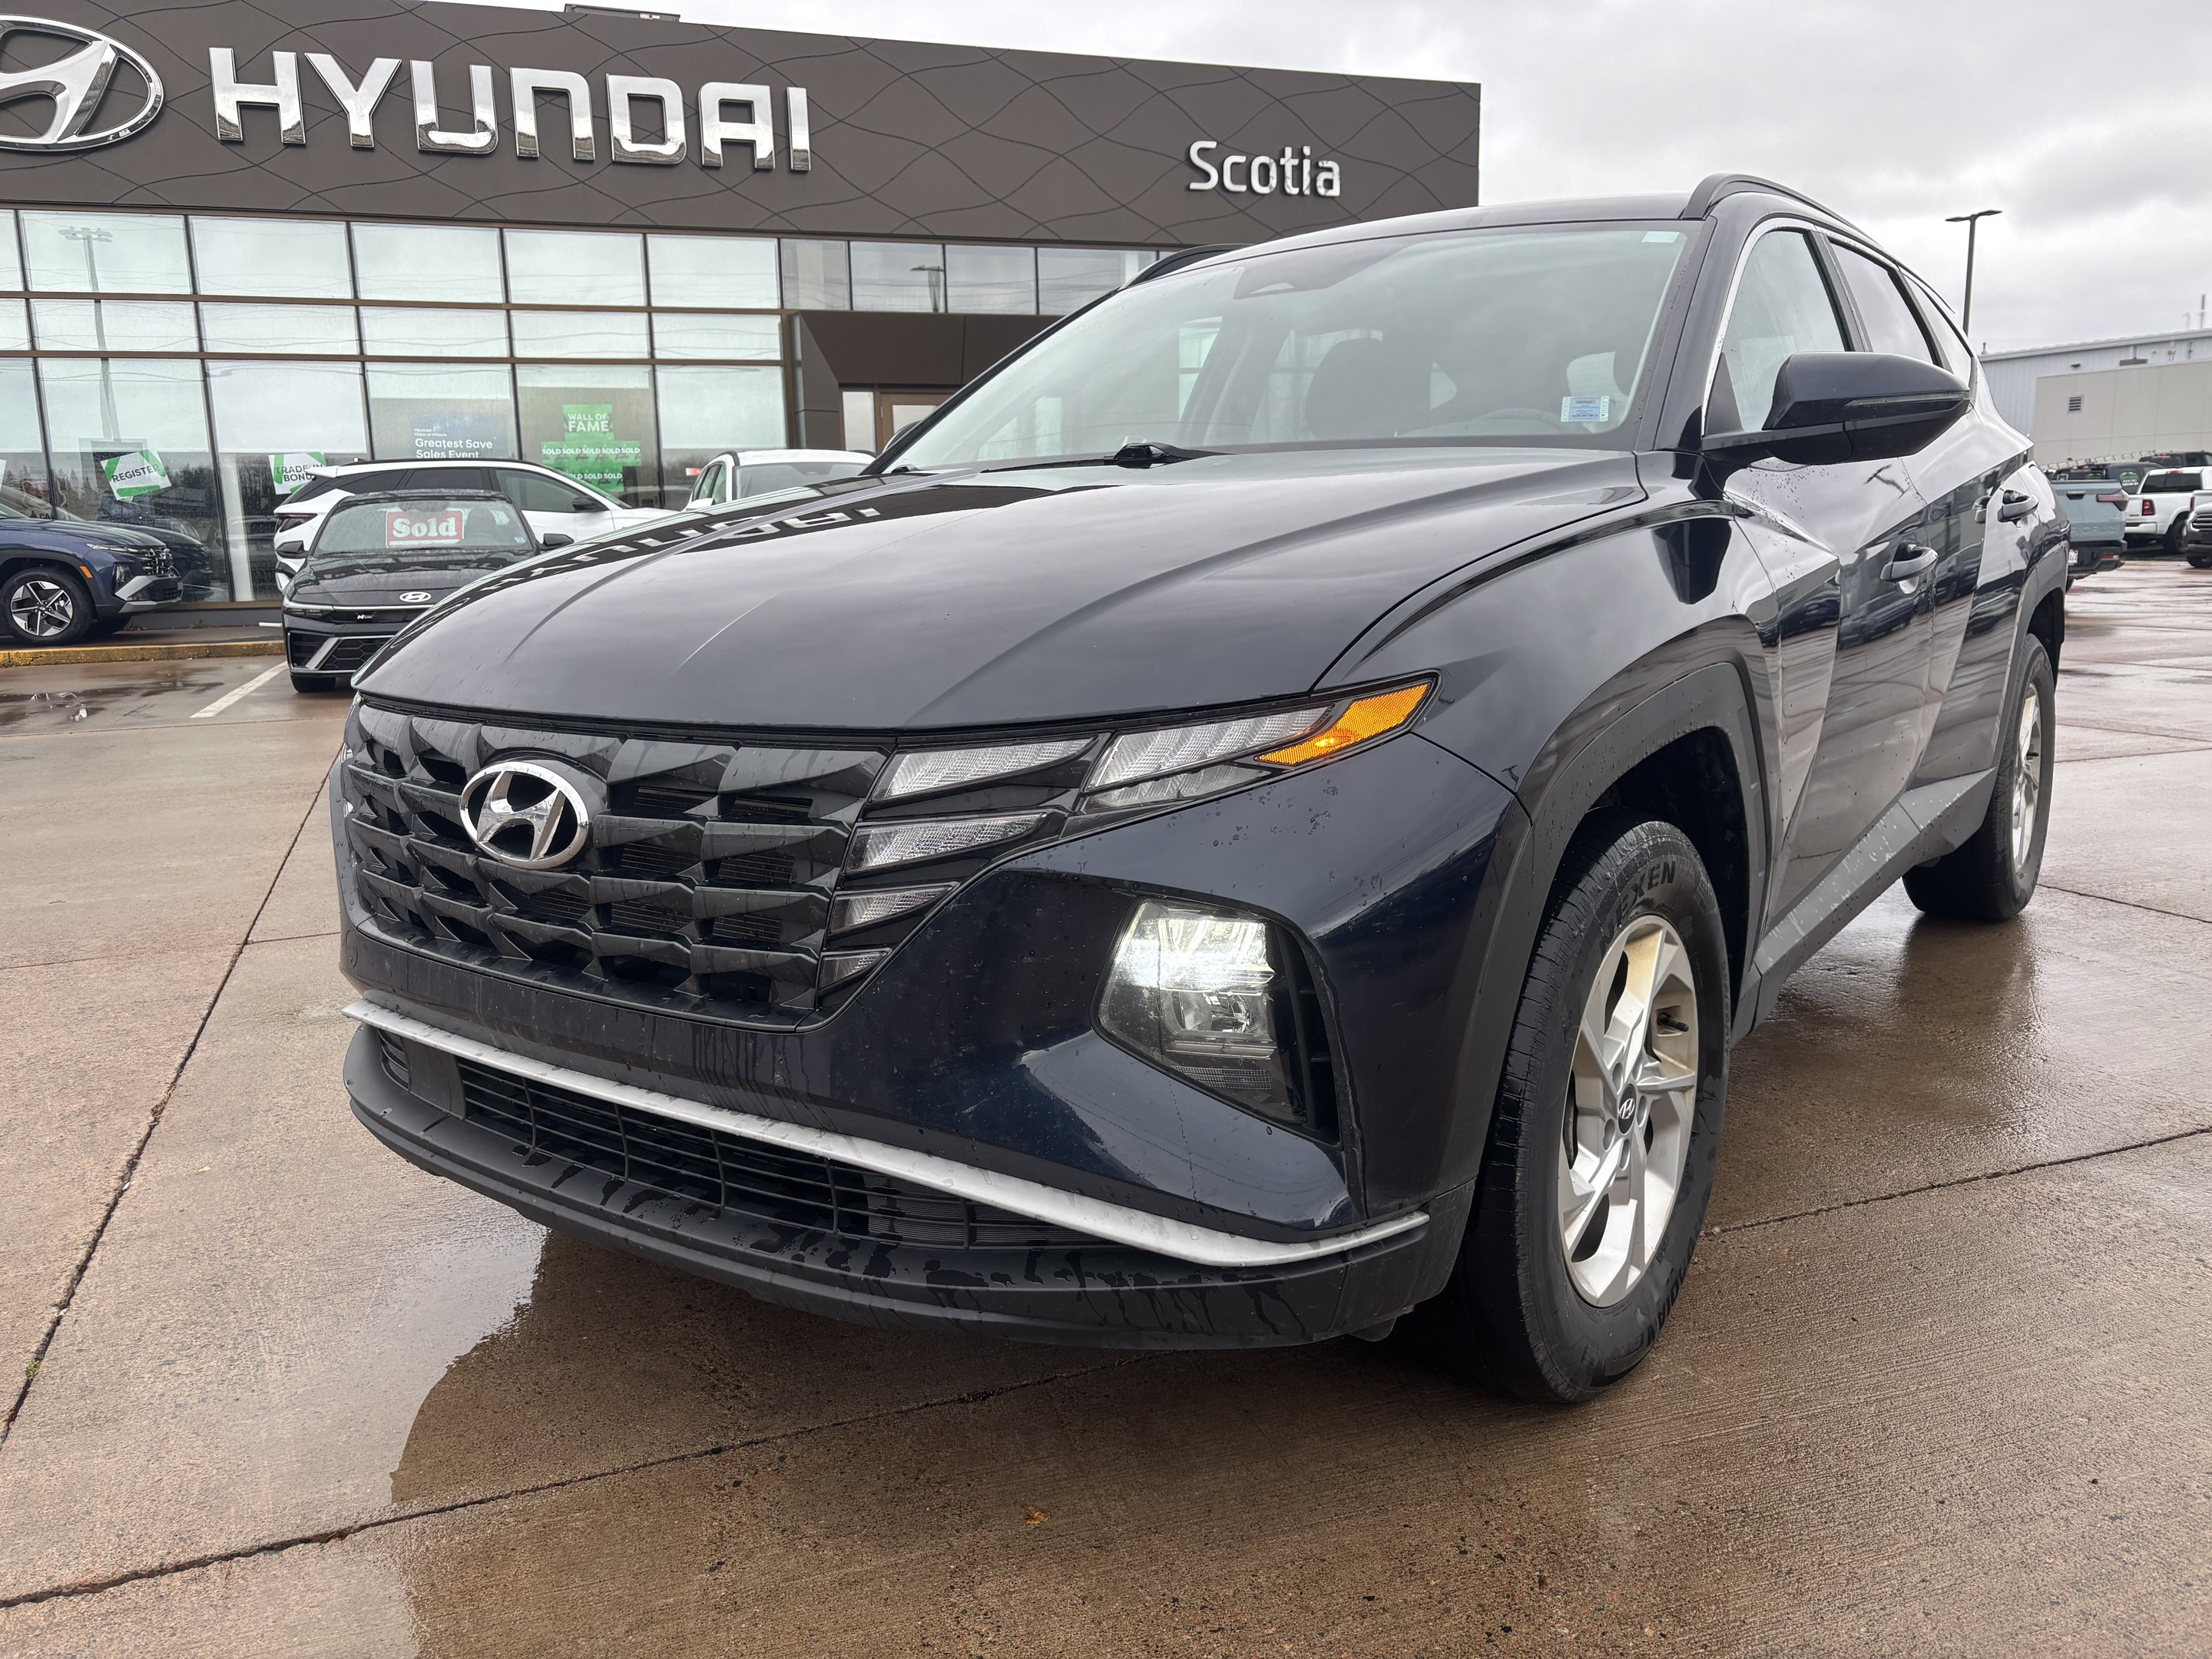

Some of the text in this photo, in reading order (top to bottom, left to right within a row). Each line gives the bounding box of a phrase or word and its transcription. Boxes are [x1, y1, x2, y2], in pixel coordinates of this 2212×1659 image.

[208, 47, 810, 171] HYUNDAI
[1189, 141, 1341, 197] Scotia
[568, 421, 609, 432] FAME
[415, 438, 493, 449] Greatest Save
[416, 449, 479, 459] Sales Event
[111, 464, 161, 482] REGISTER
[275, 464, 323, 474] TRADE-
[392, 517, 458, 538] Sold
